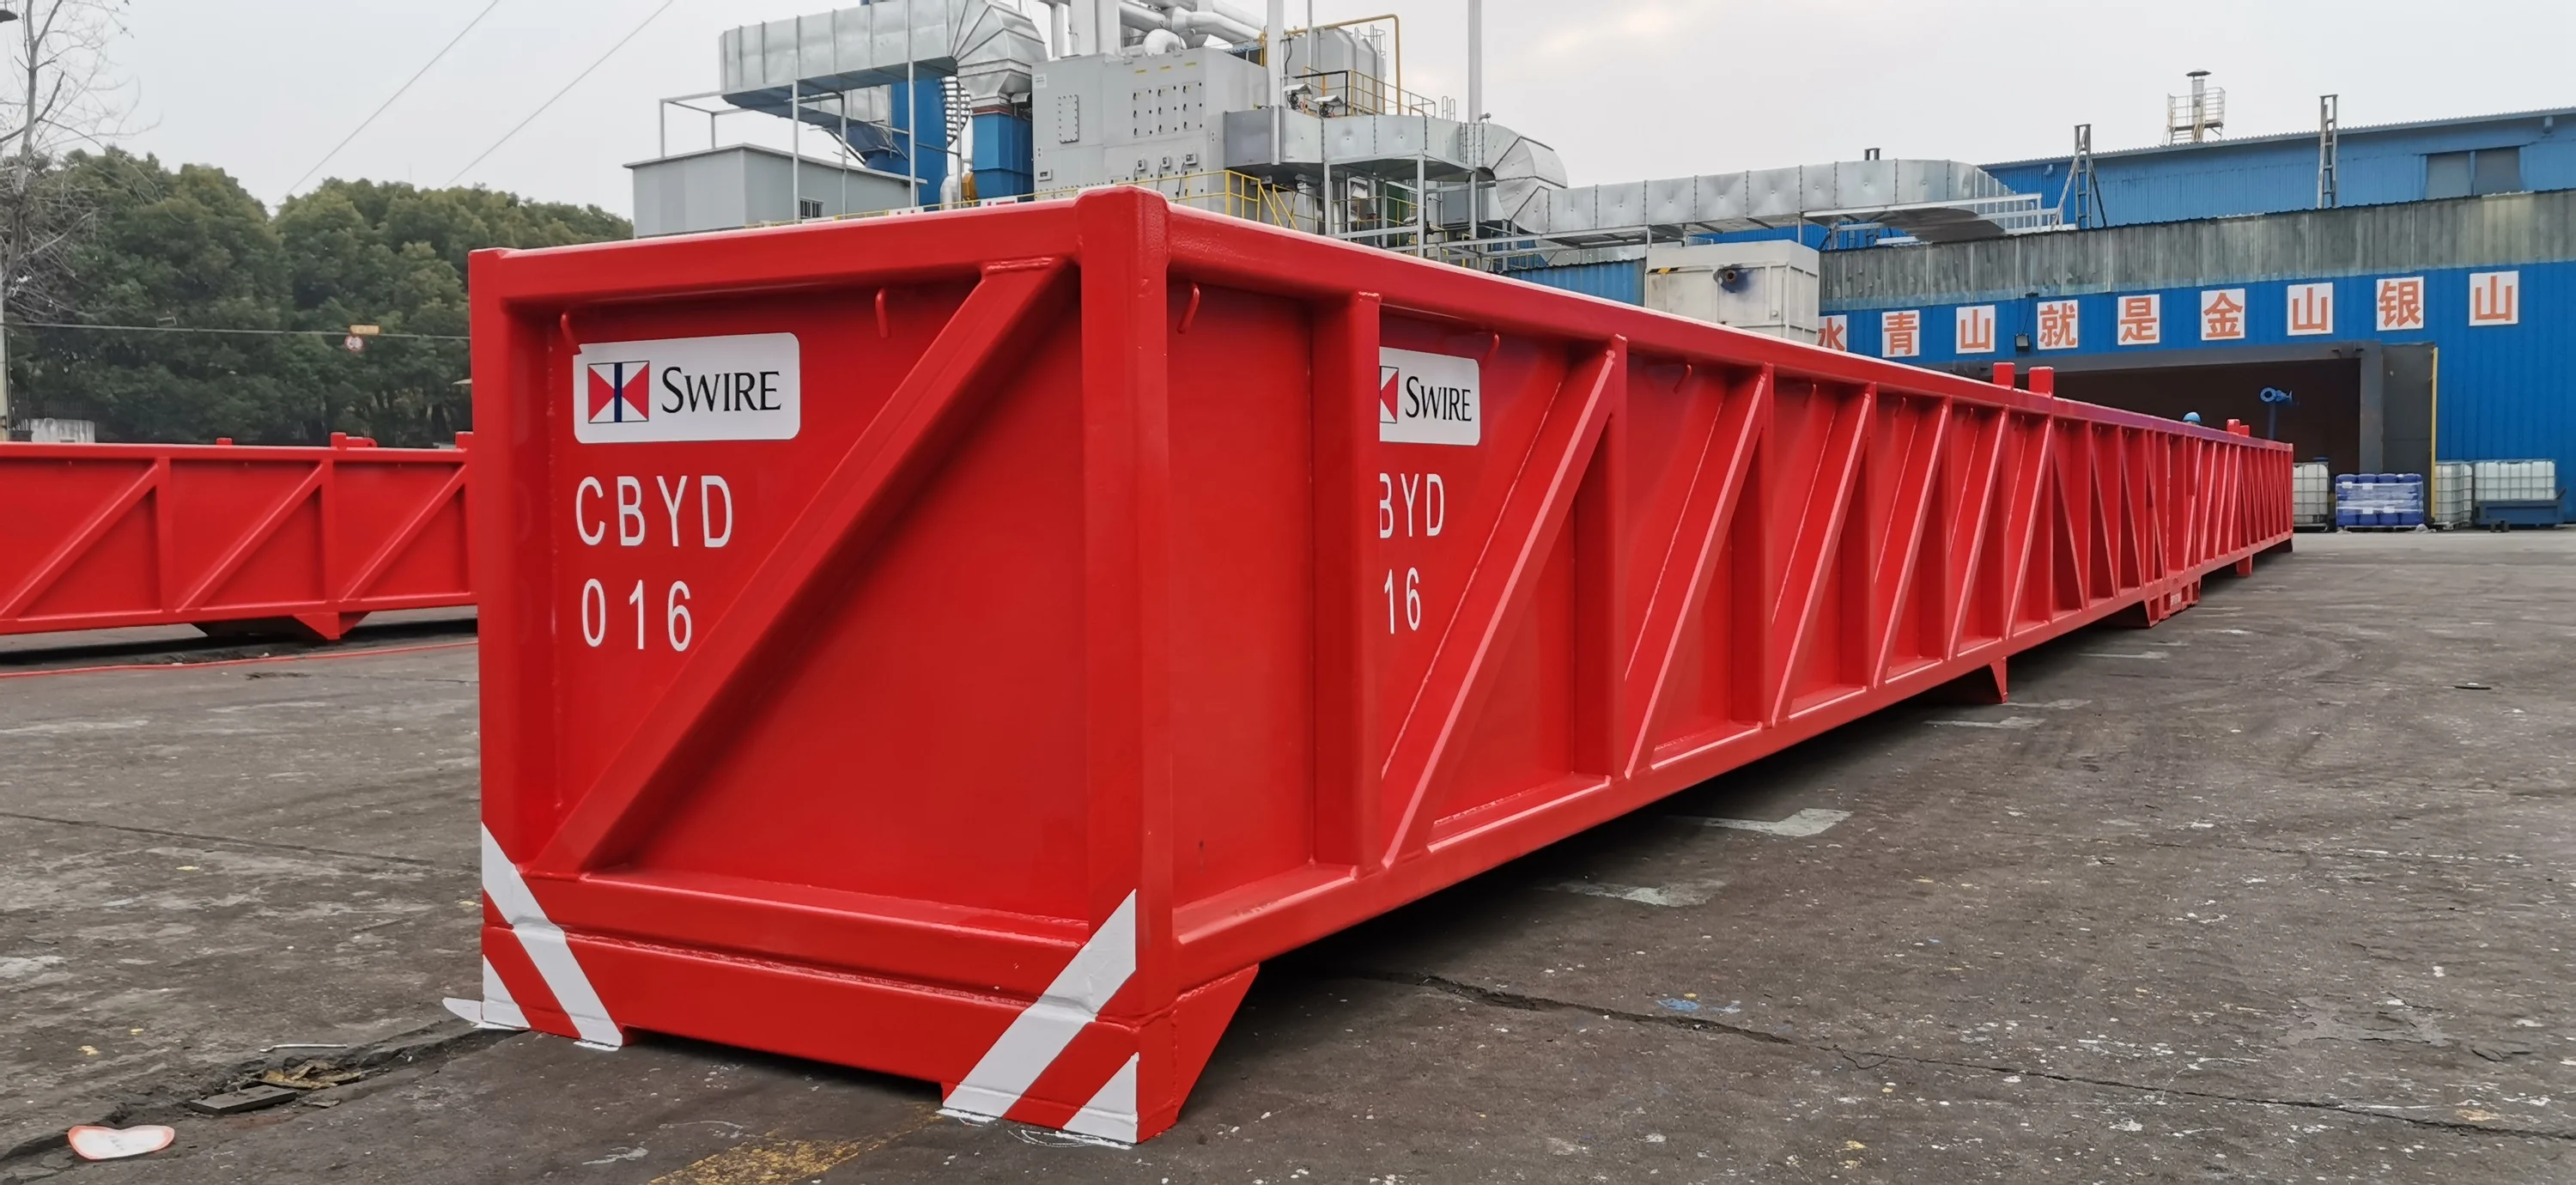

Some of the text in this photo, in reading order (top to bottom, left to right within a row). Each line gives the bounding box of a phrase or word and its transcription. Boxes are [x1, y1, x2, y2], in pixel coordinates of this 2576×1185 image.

[575, 475, 733, 548] CBYD
[1379, 472, 1445, 539] BYD
[581, 578, 692, 652] 016
[1383, 567, 1421, 635] 16
